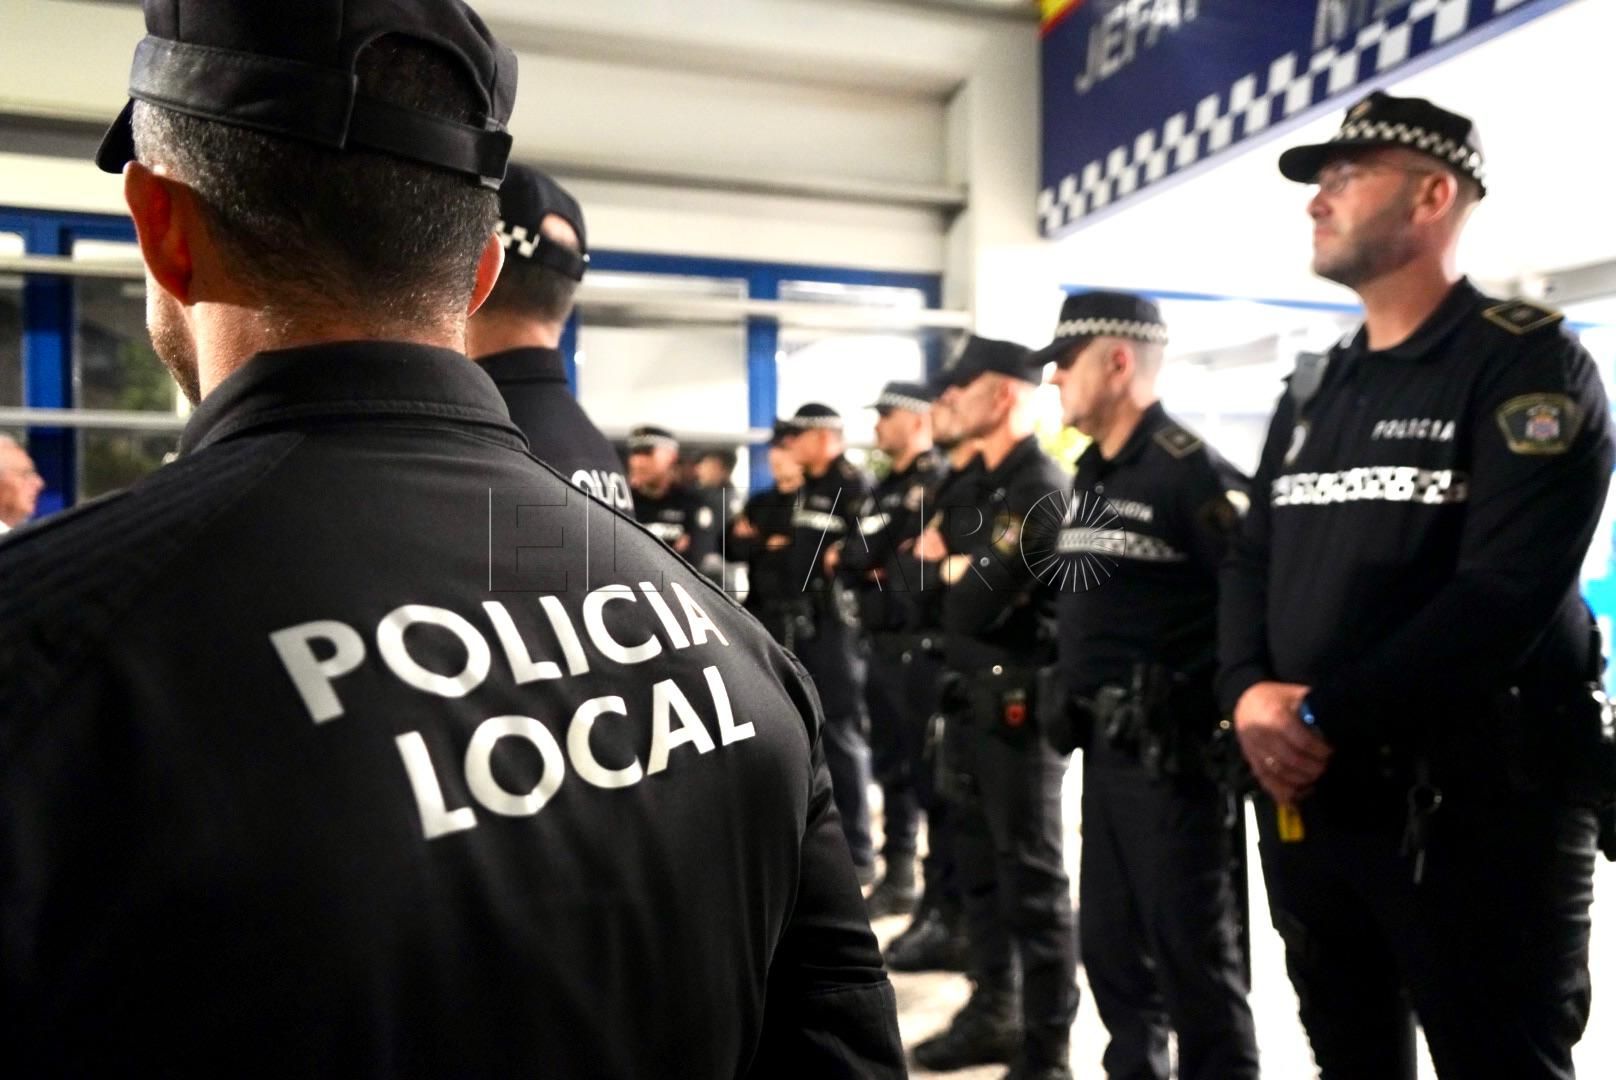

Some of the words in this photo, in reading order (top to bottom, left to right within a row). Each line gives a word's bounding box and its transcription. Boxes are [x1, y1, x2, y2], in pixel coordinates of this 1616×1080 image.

[1370, 418, 1456, 441] POLICIA
[269, 581, 730, 724] POLICIA
[395, 665, 756, 840] LOCAL
